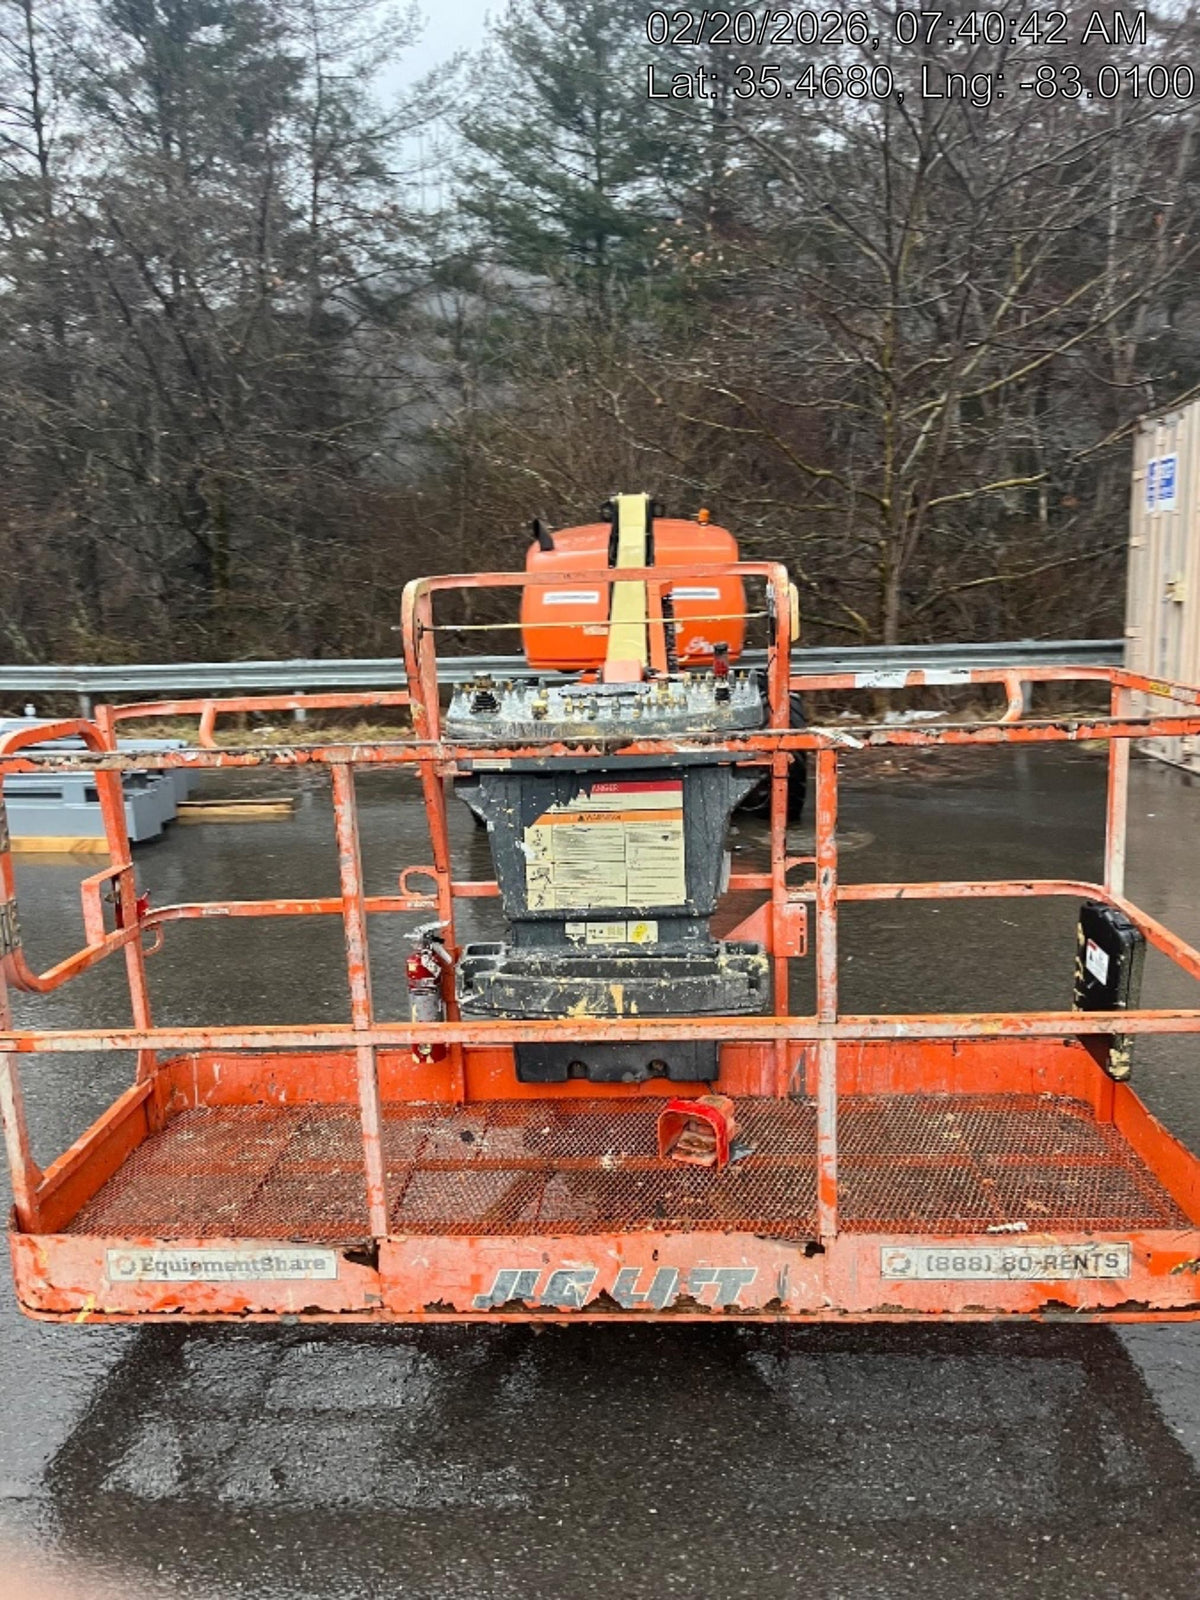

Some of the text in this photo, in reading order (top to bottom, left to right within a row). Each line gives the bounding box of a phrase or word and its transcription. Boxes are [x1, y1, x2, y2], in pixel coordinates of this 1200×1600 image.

[141, 1256, 327, 1276] EquipmentShare
[925, 1252, 1120, 1273] (888) 80-RENTS
[472, 1267, 758, 1310] JLG LIFT
